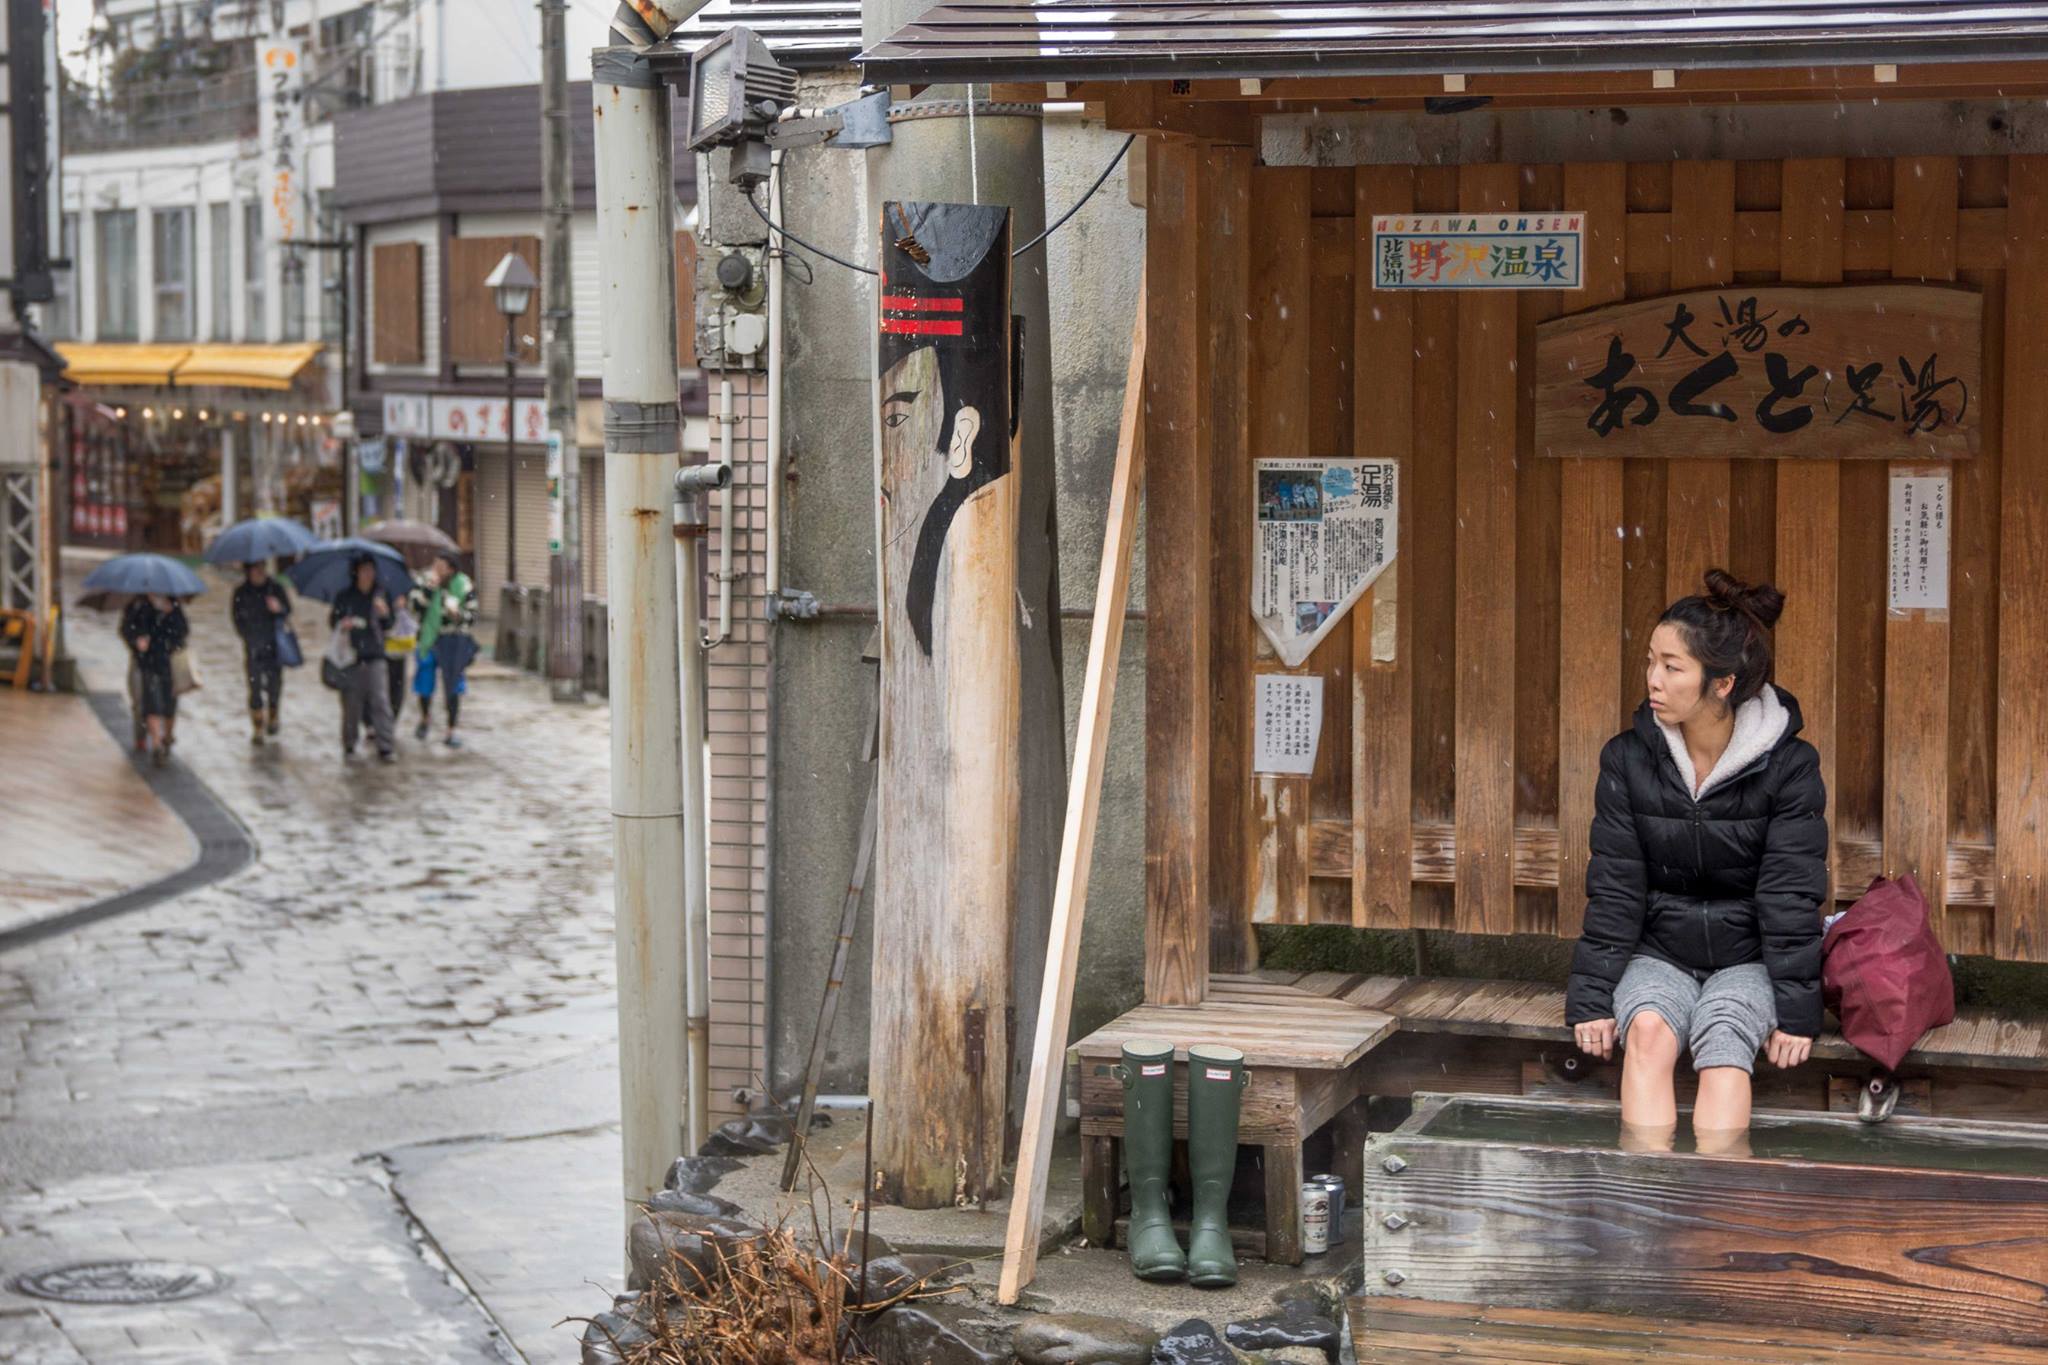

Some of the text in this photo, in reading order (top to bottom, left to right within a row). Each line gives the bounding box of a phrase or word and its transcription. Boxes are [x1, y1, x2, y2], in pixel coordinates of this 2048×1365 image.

[1377, 218, 1580, 232] NOZAWA ONSEN
[1383, 239, 1404, 284] 北信州
[1407, 239, 1569, 282] 野沢温泉
[1656, 296, 1811, 359] 大湯の
[1360, 464, 1382, 508] 足湯
[1919, 502, 1930, 597] お気軽に御利用下さい。
